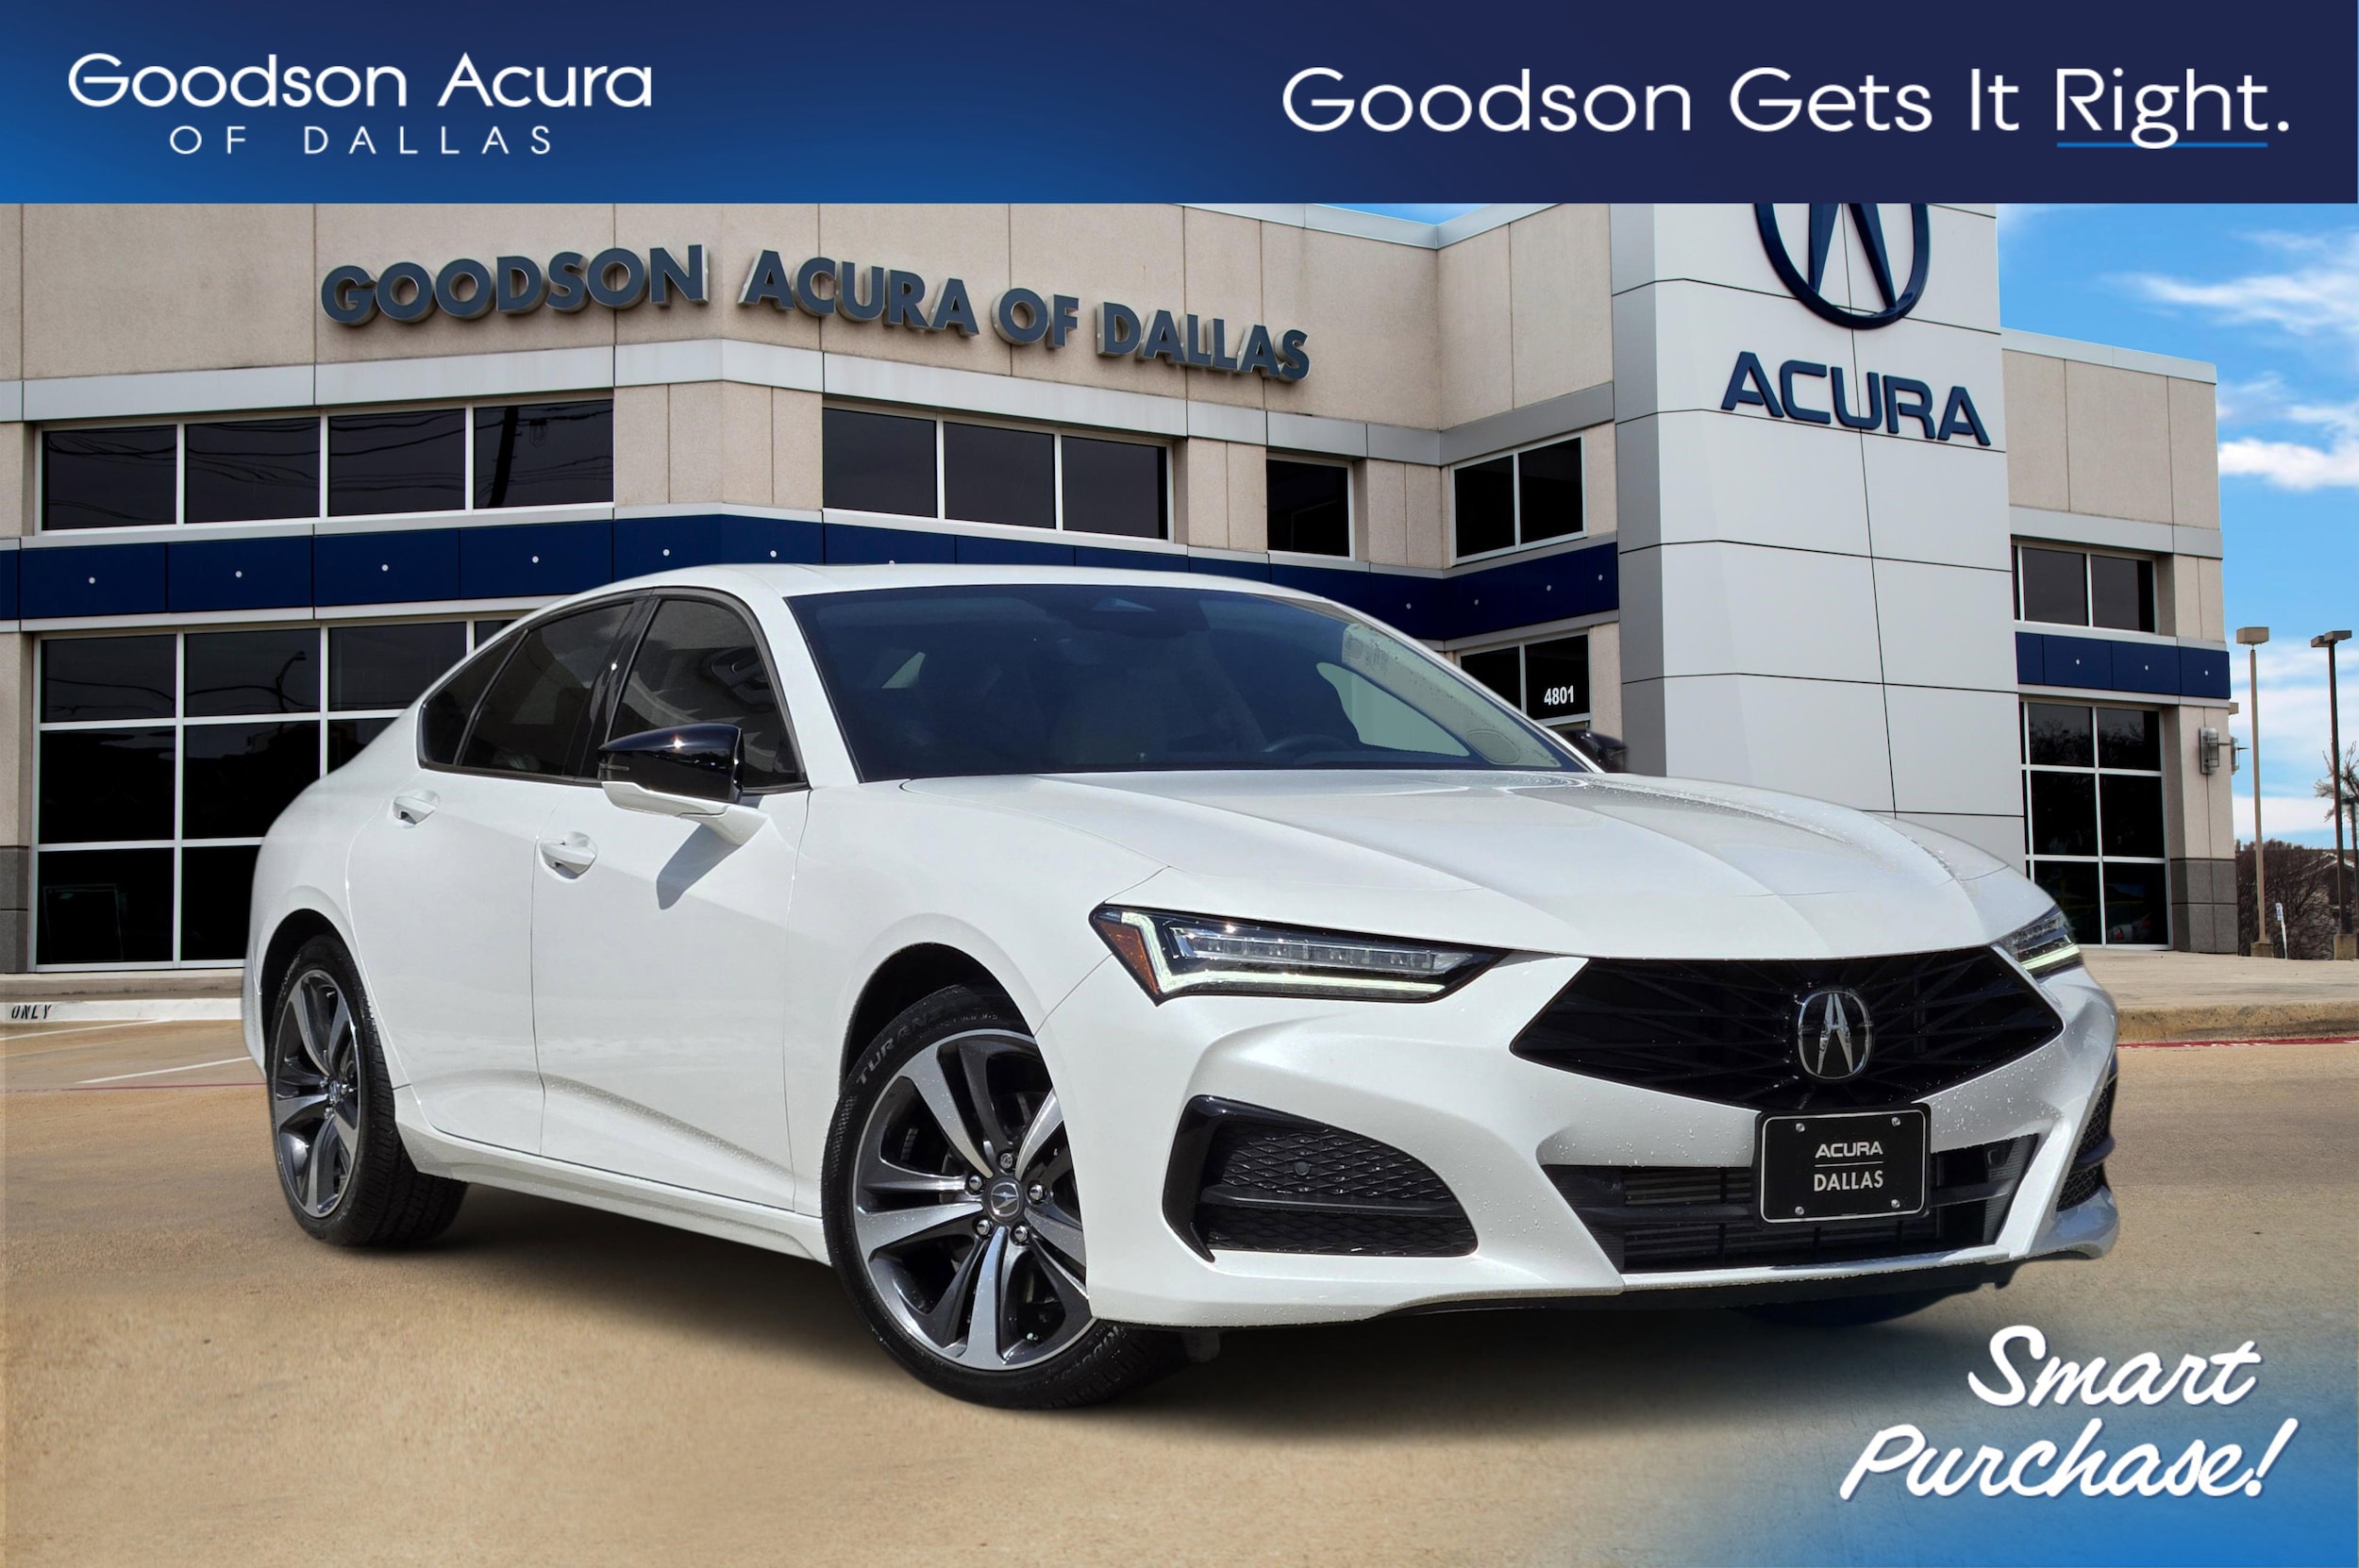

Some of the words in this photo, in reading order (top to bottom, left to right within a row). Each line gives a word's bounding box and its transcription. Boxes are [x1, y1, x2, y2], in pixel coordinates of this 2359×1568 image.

[321, 243, 709, 326] GOODSON
[738, 249, 980, 336] ACURA
[992, 288, 1079, 348] OF
[1096, 301, 1312, 382] DALLAS
[1720, 351, 1992, 446] ACURA
[1544, 685, 1574, 706] 4801
[11, 1005, 52, 1019] ONLY
[1815, 1141, 1883, 1159] ACURA
[1814, 1170, 1883, 1192] DALLAS
